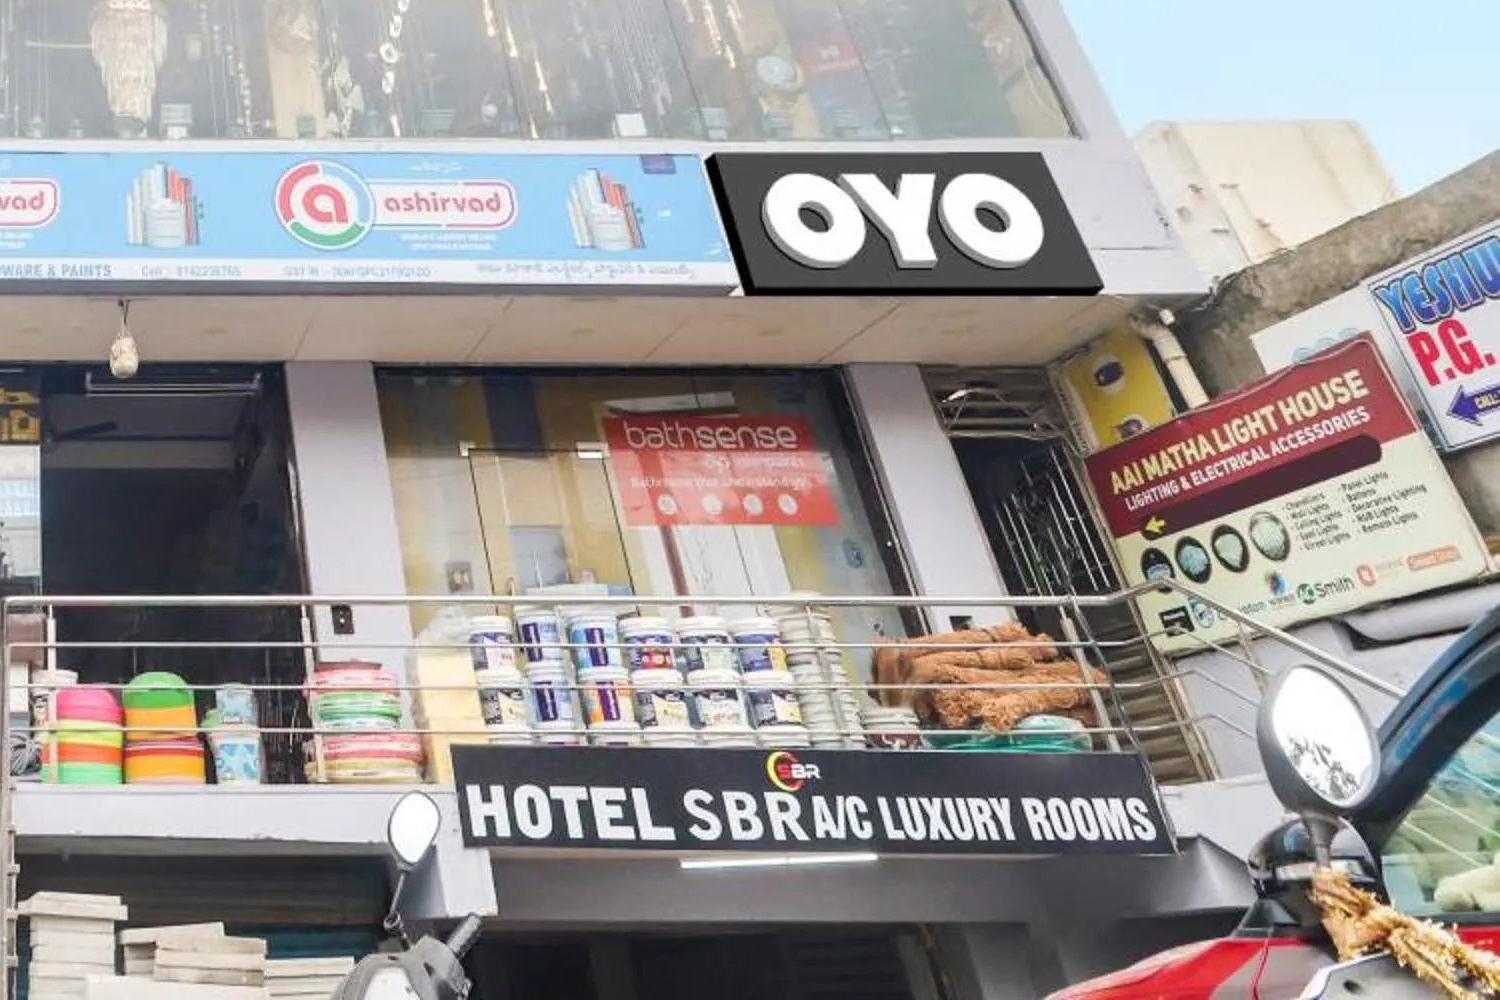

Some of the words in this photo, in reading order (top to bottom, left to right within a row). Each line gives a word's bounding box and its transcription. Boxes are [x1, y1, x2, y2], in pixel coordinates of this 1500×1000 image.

[383, 190, 502, 214] ashirvad
[760, 172, 1045, 270] OYO
[46, 264, 57, 279] &
[60, 263, 113, 279] PAINTS
[1406, 318, 1497, 388] P.G.
[623, 420, 797, 449] bathsense
[1110, 464, 1145, 495] AAI
[1142, 436, 1216, 479] MATHA
[1211, 405, 1278, 458] LIGHT
[1278, 368, 1370, 427] HOUSE
[1125, 480, 1180, 512] LIGHTING
[1192, 447, 1271, 488] ELECTRICAL
[1269, 406, 1371, 457] ACCESSORIES
[465, 785, 676, 840] HOTEL
[685, 788, 810, 842] SBR
[814, 796, 873, 840] A/C
[877, 795, 1017, 841] LUXURY
[1024, 796, 1157, 842] ROOMS
